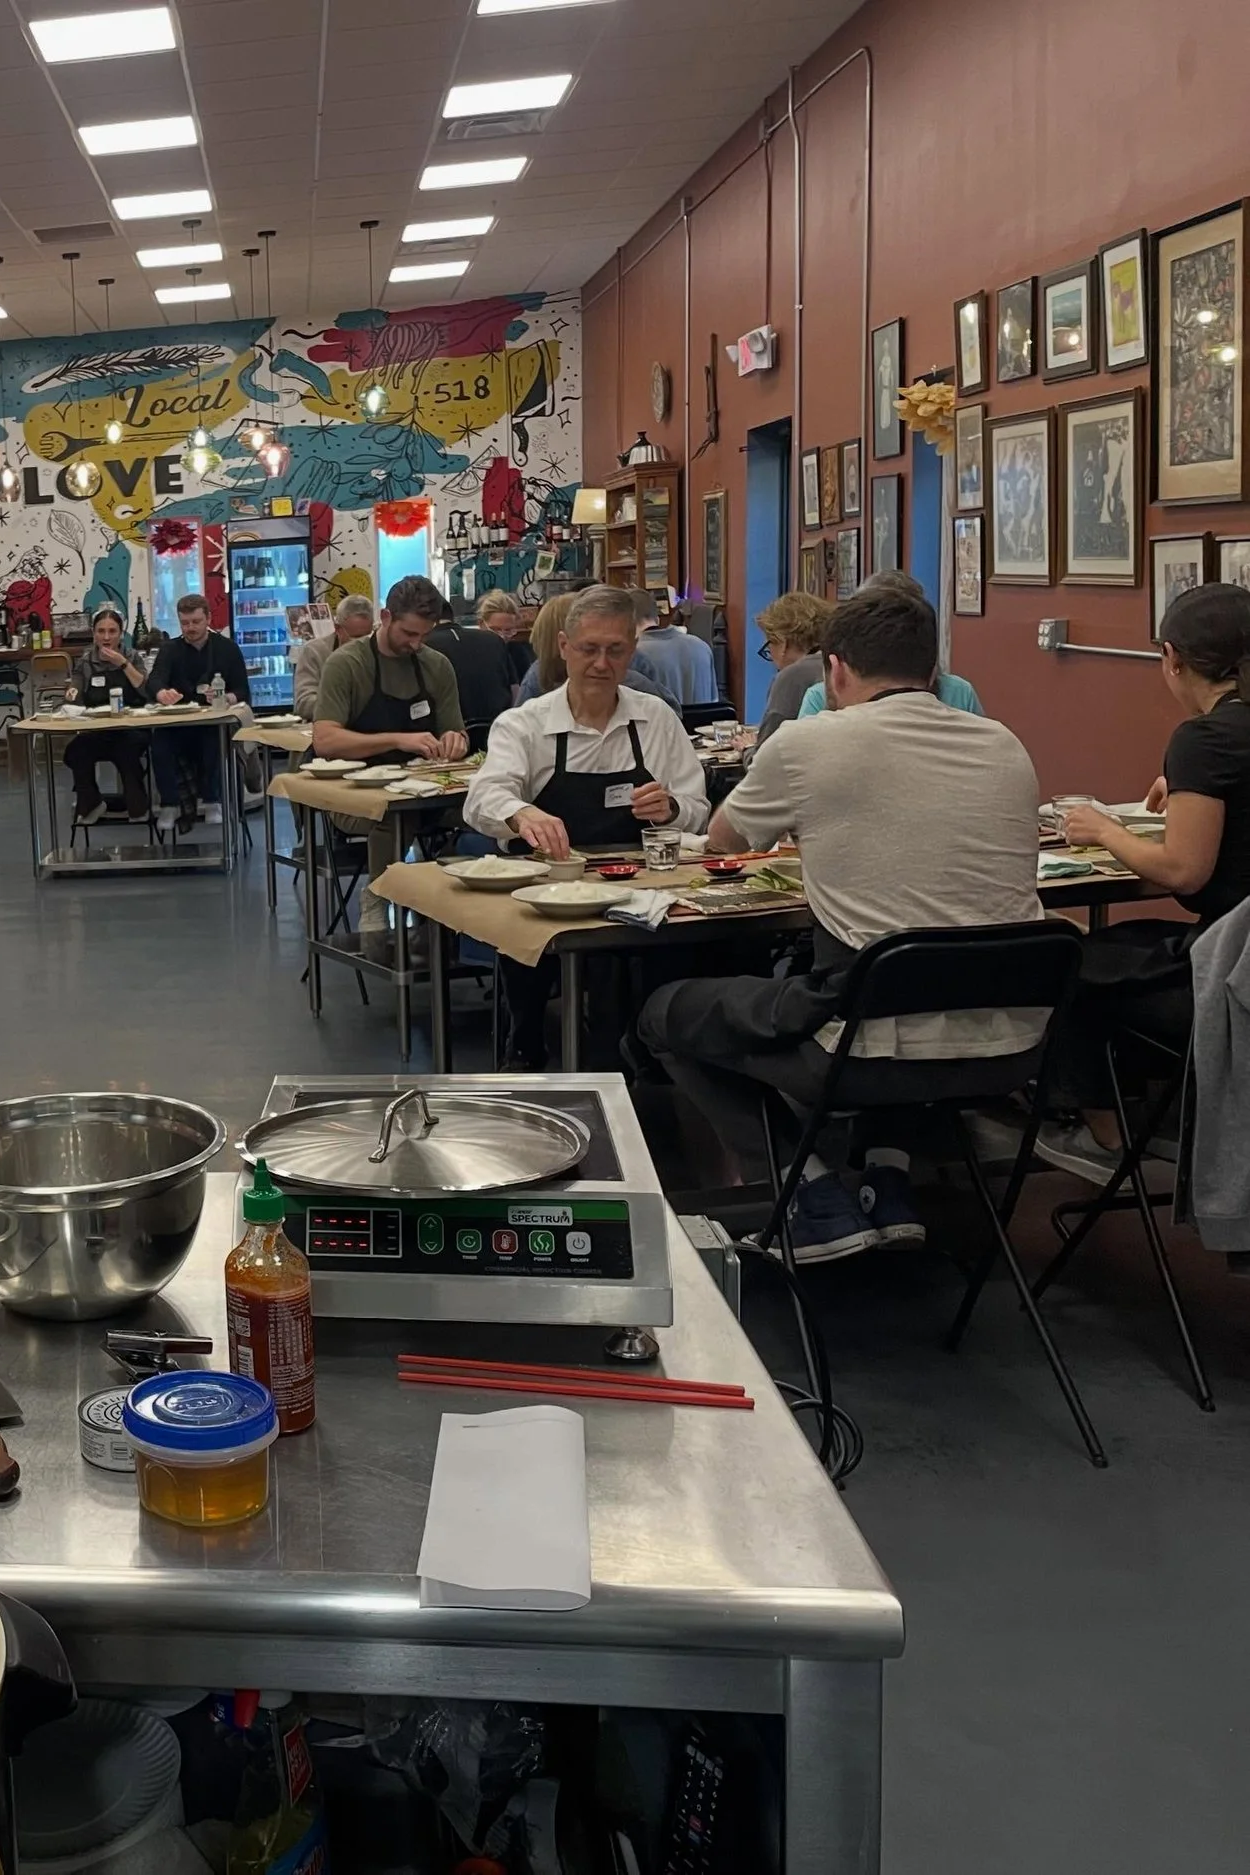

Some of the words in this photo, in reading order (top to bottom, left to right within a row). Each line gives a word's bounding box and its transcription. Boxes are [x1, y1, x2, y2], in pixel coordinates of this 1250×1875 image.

[119, 378, 231, 428] Local
[434, 374, 490, 404] 518
[511, 1214, 570, 1224] SPECTRUM
